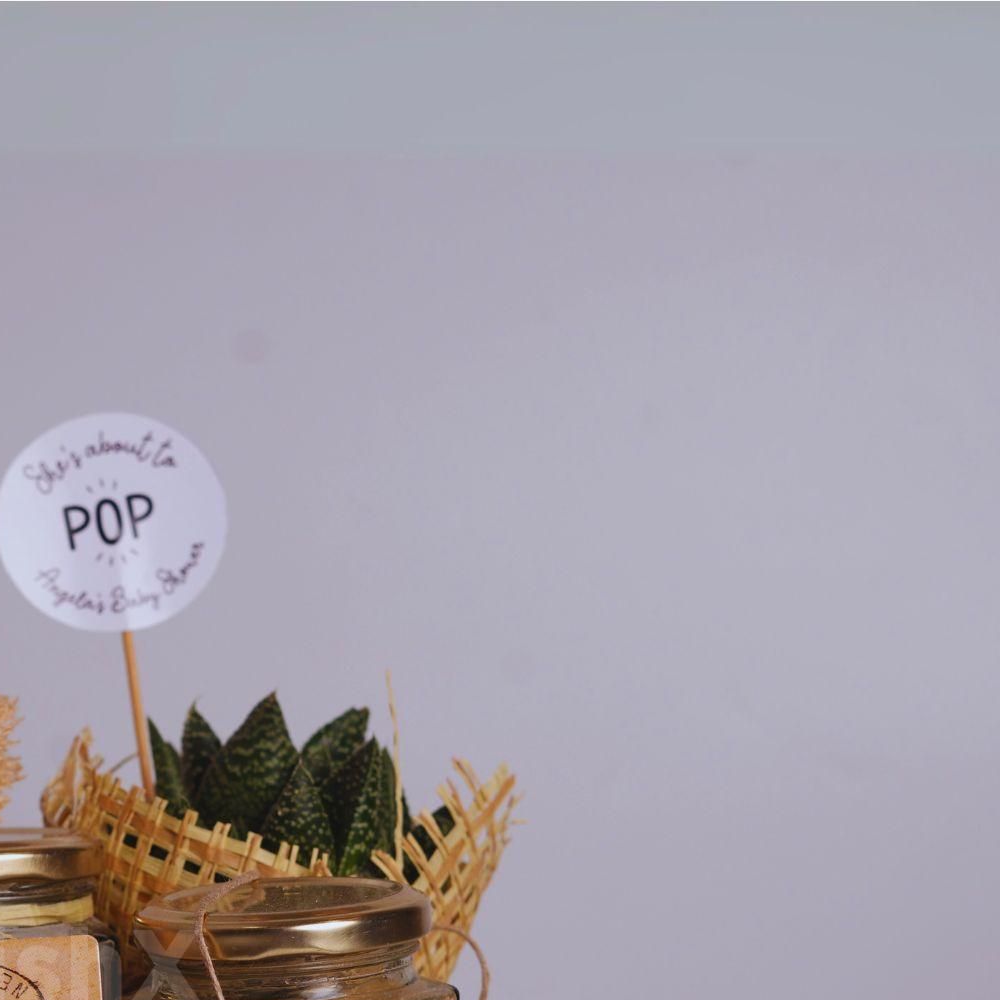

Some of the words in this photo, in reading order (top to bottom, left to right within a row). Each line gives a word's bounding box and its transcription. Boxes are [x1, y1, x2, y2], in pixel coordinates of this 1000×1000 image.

[85, 430, 152, 463] about
[151, 437, 177, 468] to
[62, 494, 154, 551] POP
